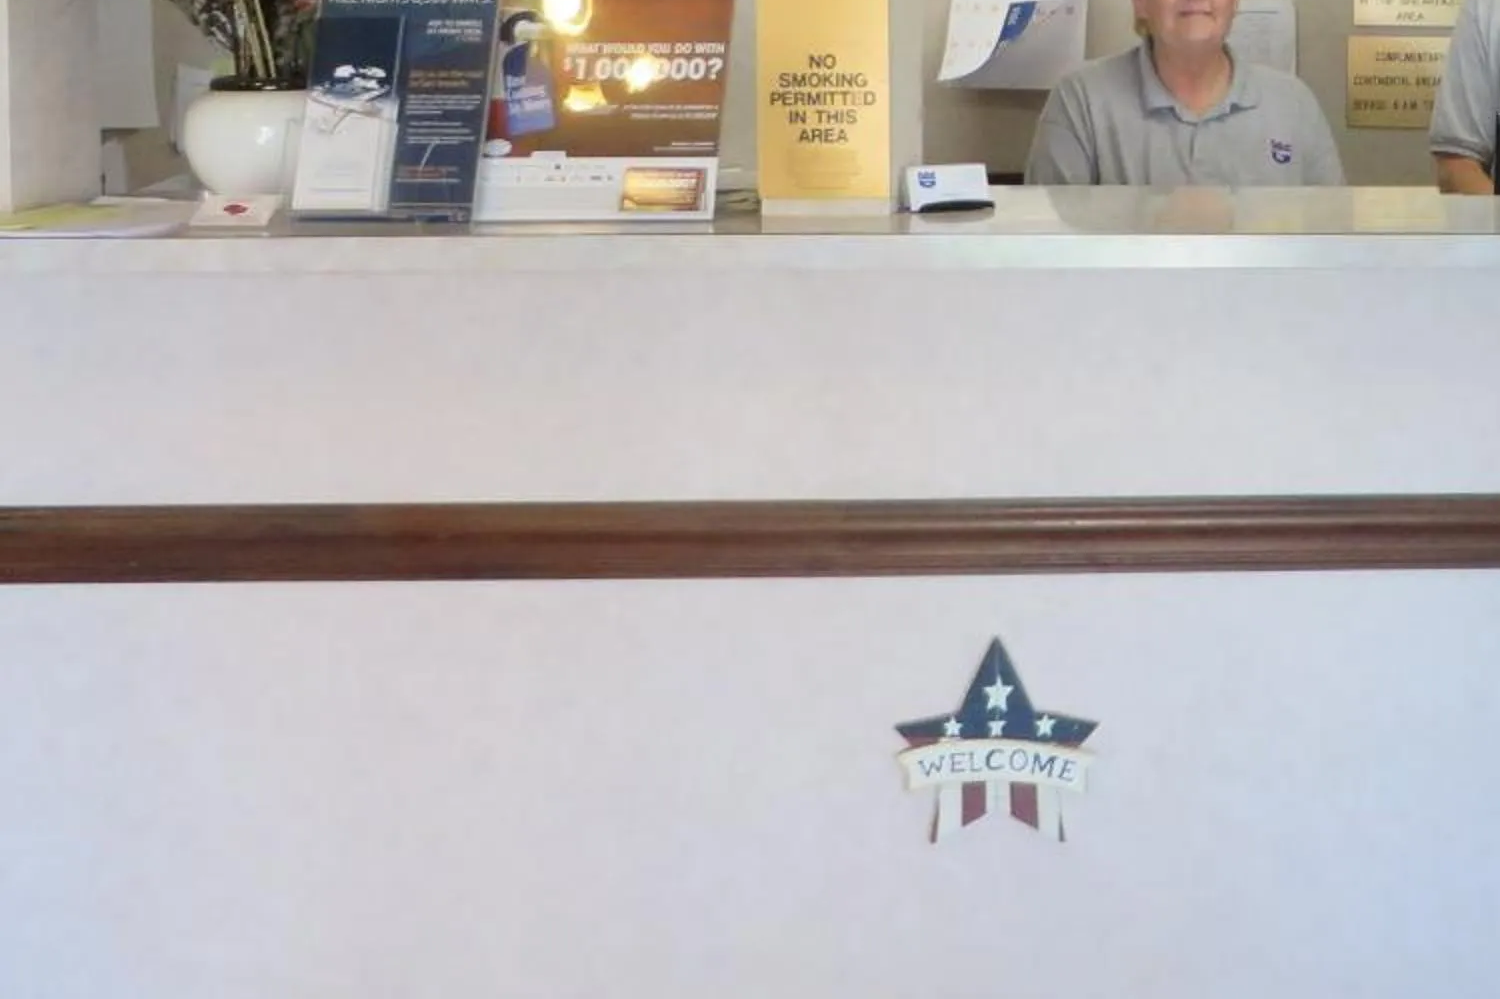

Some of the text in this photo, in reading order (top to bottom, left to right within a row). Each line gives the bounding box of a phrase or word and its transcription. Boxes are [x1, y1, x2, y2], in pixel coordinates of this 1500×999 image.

[674, 42, 692, 54] DO
[808, 53, 837, 70] NO
[778, 72, 868, 89] SMOKING
[769, 91, 876, 106] PERMITTED
[789, 109, 857, 125] IN THIS
[798, 128, 849, 144] AREA
[917, 748, 1077, 782] WELCOME
